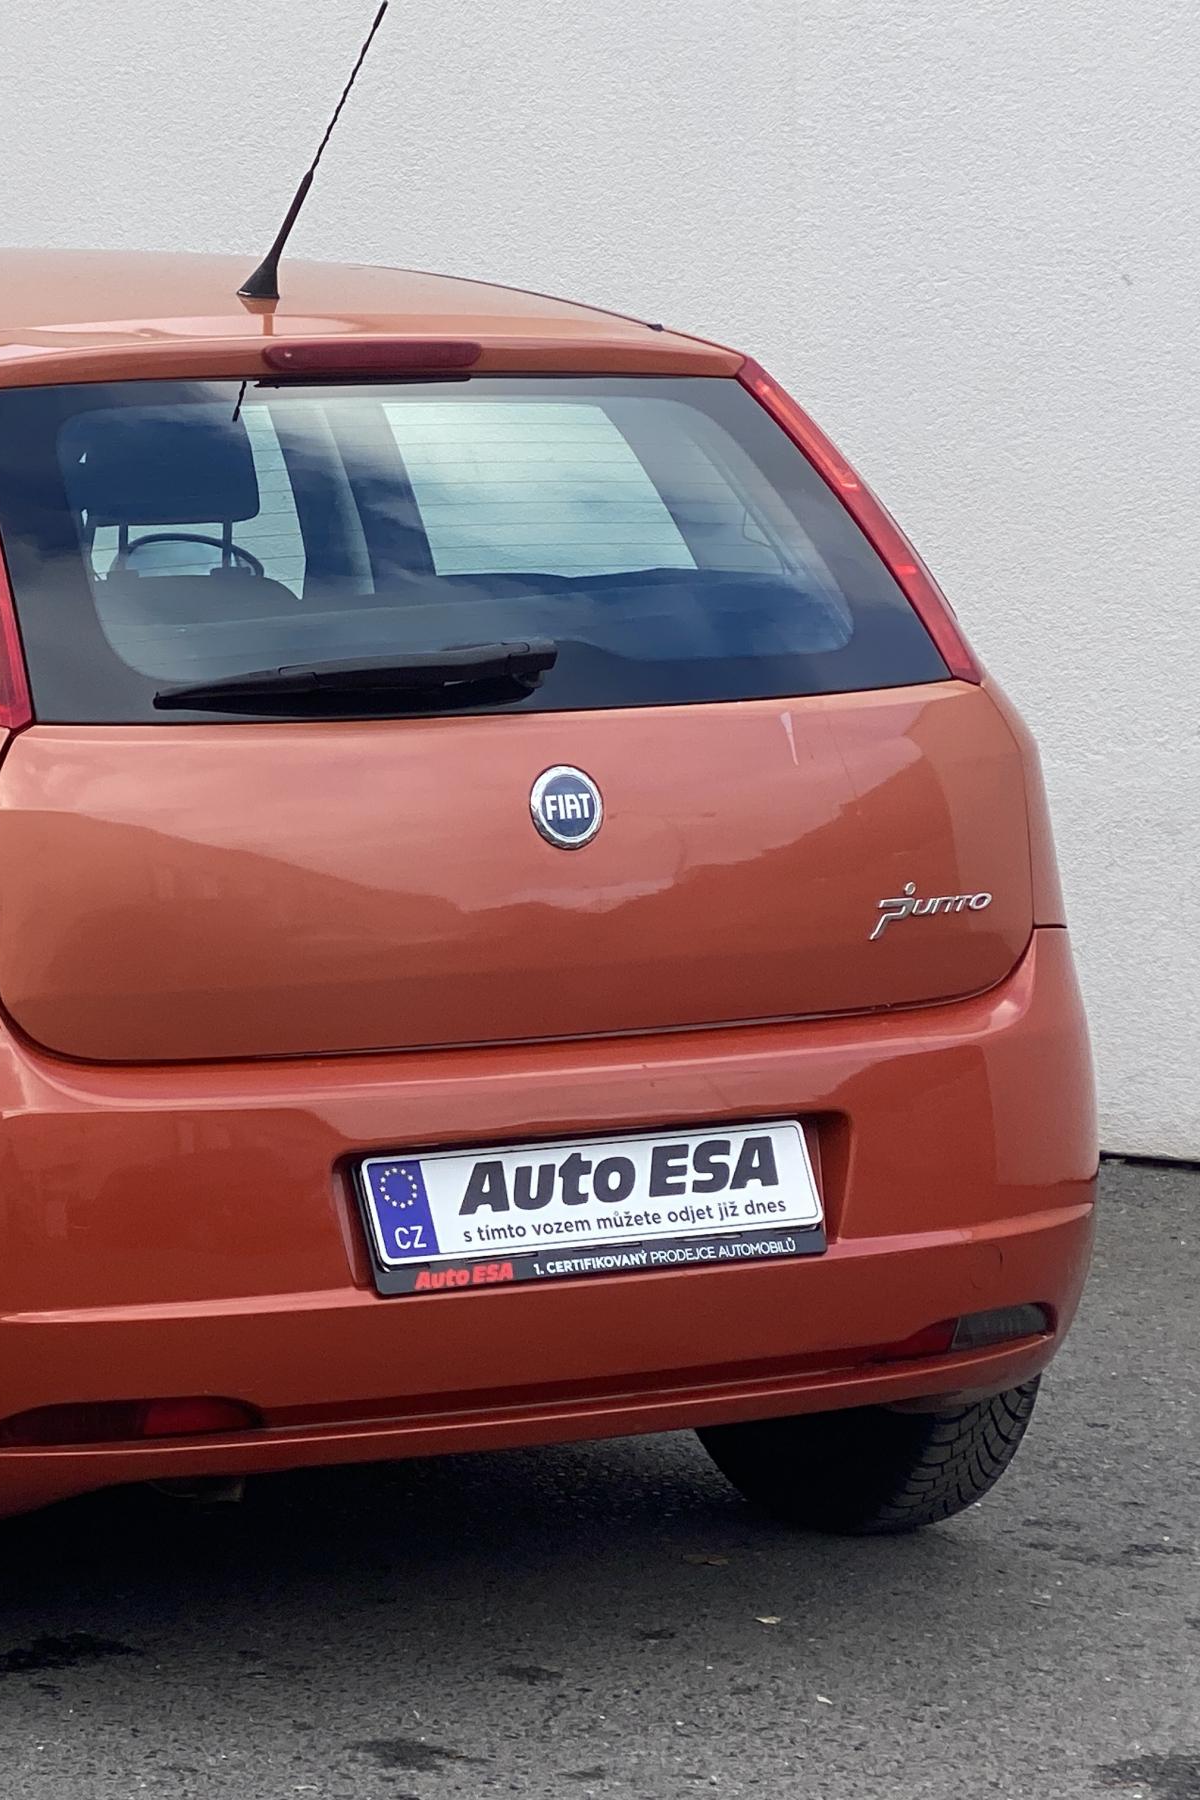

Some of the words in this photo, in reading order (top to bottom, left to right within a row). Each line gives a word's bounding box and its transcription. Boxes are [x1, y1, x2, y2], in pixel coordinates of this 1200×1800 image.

[544, 793, 591, 821] FIAT
[458, 1152, 636, 1216] Auto
[648, 1135, 780, 1198] ESA
[394, 1225, 428, 1250] CZ
[463, 1230, 473, 1243] s
[477, 1224, 527, 1242] tímto
[531, 1218, 591, 1236] vozem
[597, 1210, 661, 1230] můžete
[667, 1204, 714, 1225] odjet
[718, 1200, 739, 1221] již
[744, 1199, 786, 1216] dnes
[533, 1263, 545, 1276] 1.
[547, 1249, 648, 1274] CERTIFIKOVANÝ
[649, 1243, 716, 1264] PRODEJCE
[718, 1236, 797, 1259] AUTOMOBILŮ
[414, 1268, 471, 1290] Auto
[472, 1262, 514, 1284] ESA
